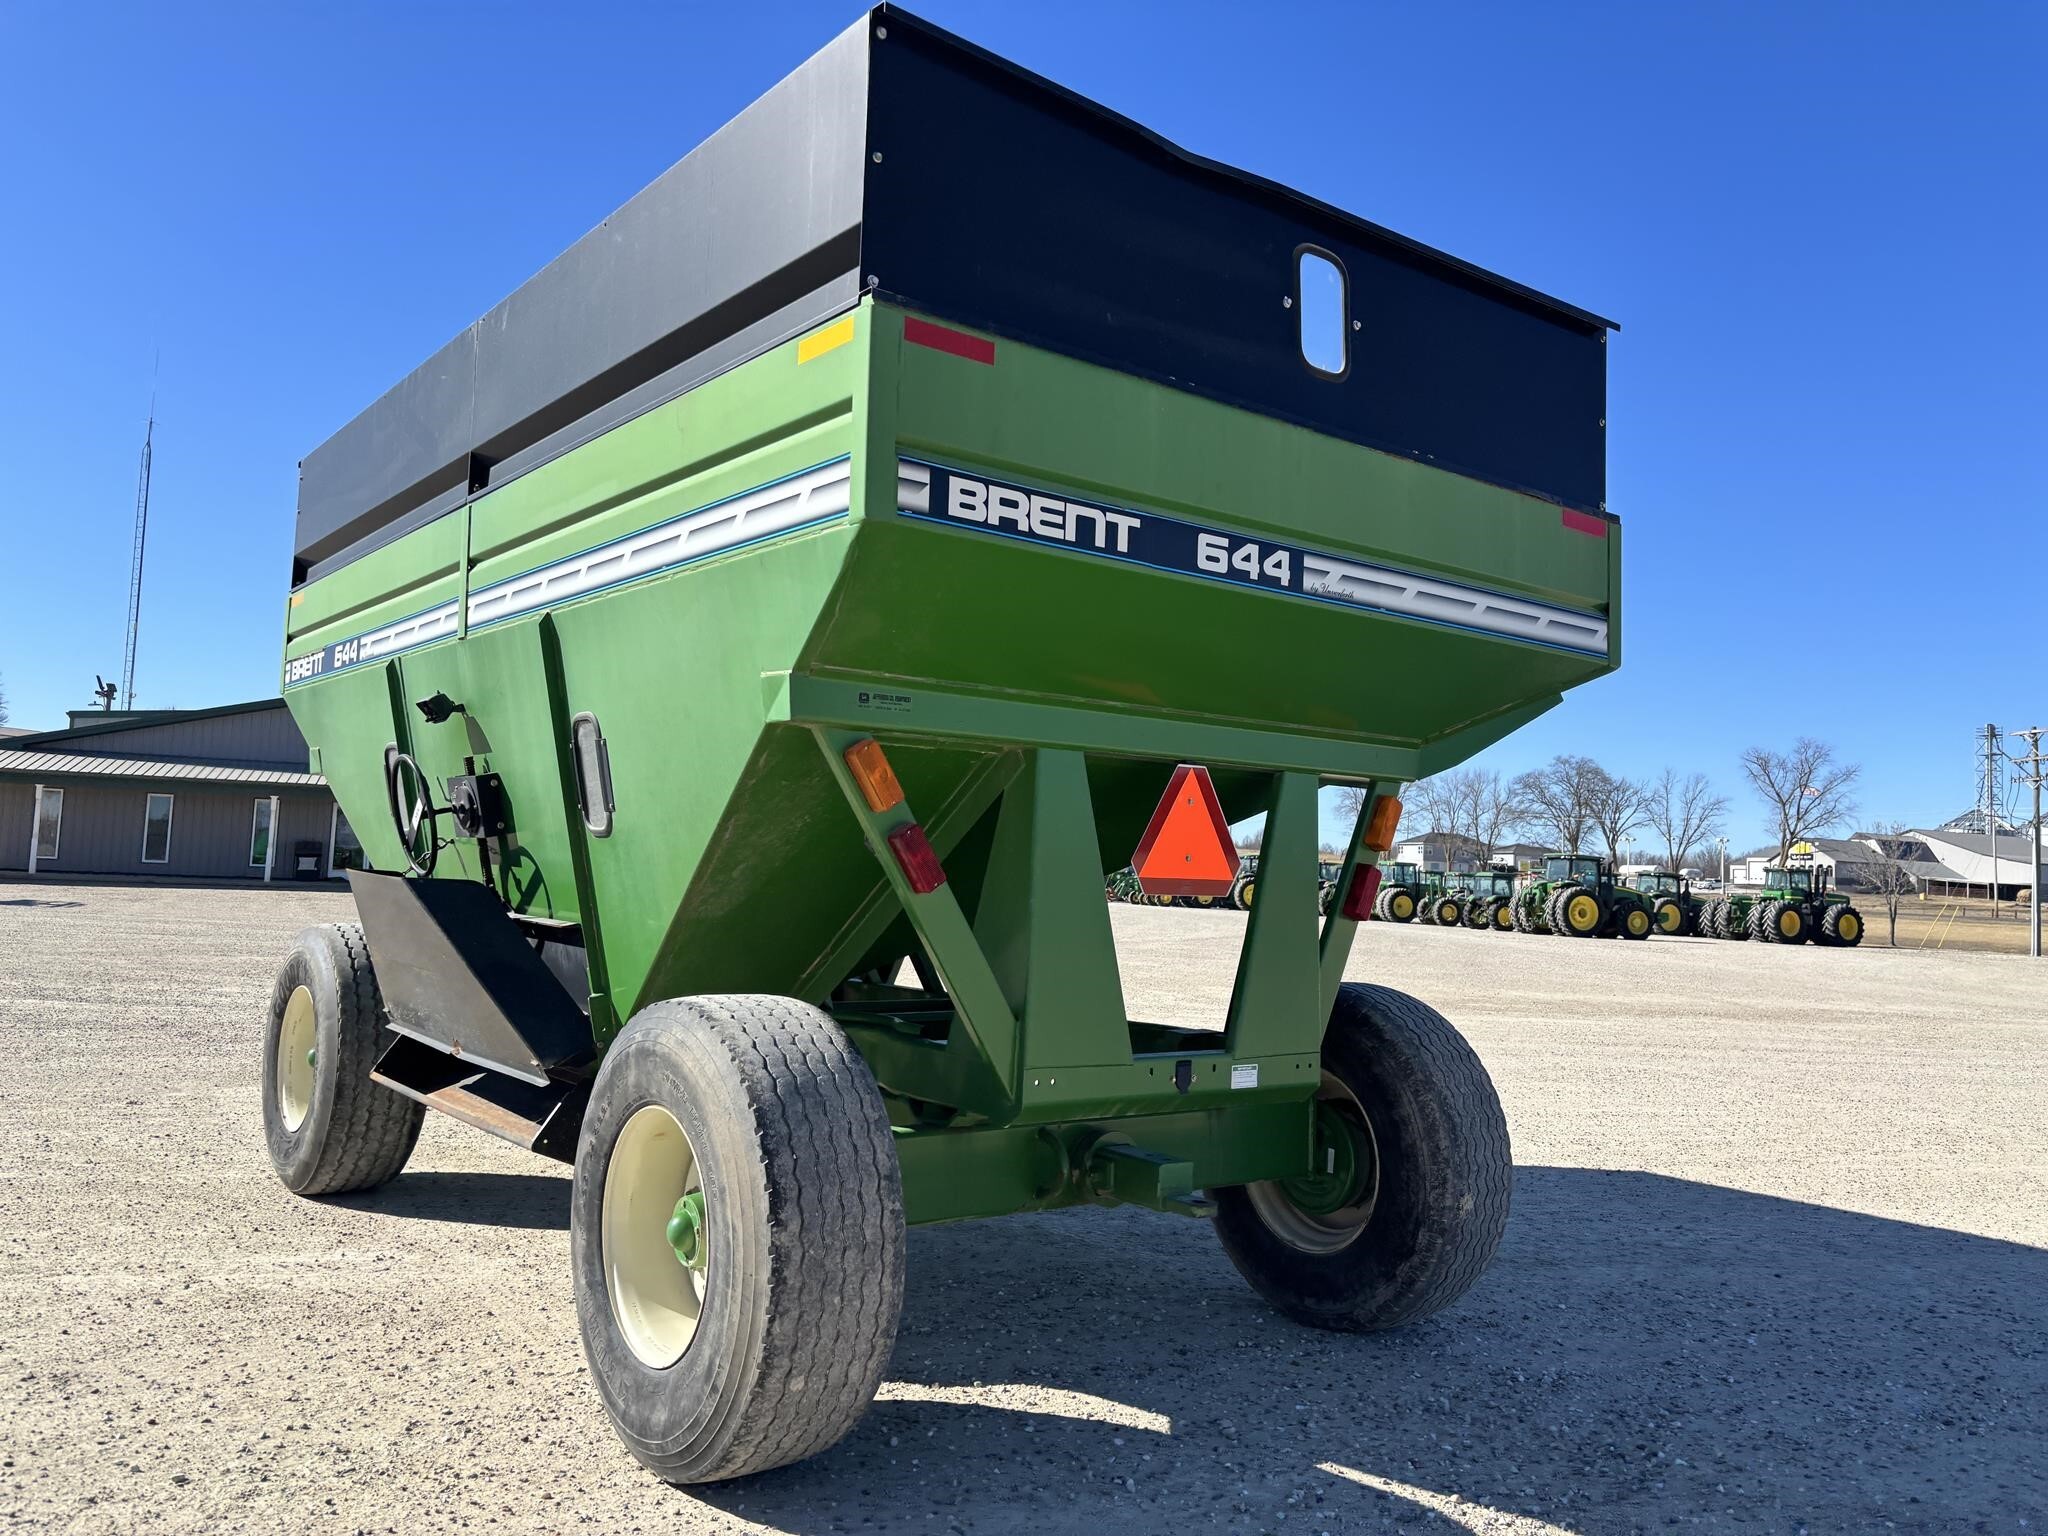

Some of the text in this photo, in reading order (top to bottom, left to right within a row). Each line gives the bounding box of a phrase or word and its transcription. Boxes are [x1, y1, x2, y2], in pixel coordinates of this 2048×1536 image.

[948, 475, 1291, 587] BRENT 644
[291, 651, 325, 681] BRENT
[334, 640, 358, 668] 644
